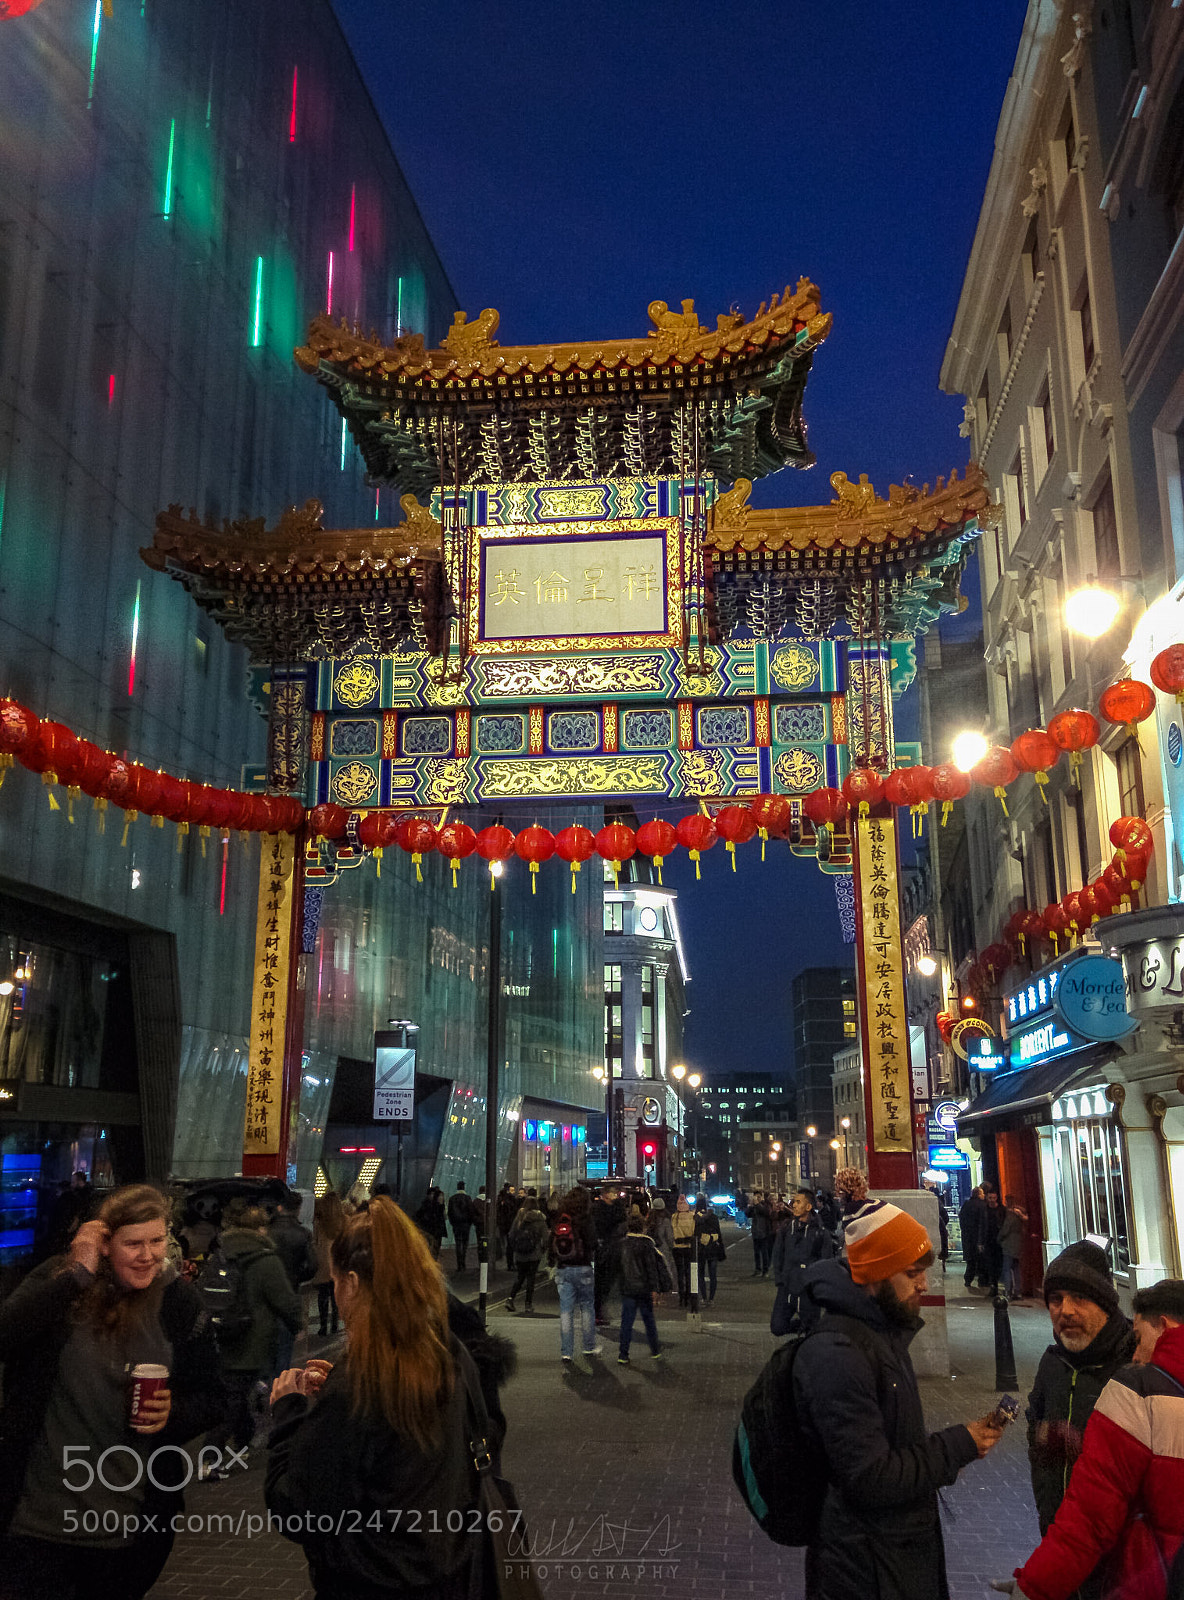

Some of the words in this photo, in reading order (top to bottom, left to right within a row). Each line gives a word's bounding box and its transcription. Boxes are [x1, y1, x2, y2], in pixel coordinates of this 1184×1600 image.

[489, 564, 660, 606] 英倫呈祥
[1140, 957, 1160, 992] &
[1161, 947, 1184, 998] L
[1066, 978, 1124, 996] Morde
[1081, 996, 1094, 1013] &
[1097, 995, 1126, 1016] Lea
[376, 1091, 412, 1099] Pedestrian
[378, 1107, 409, 1117] ENDS
[131, 1383, 142, 1415] COSTA
